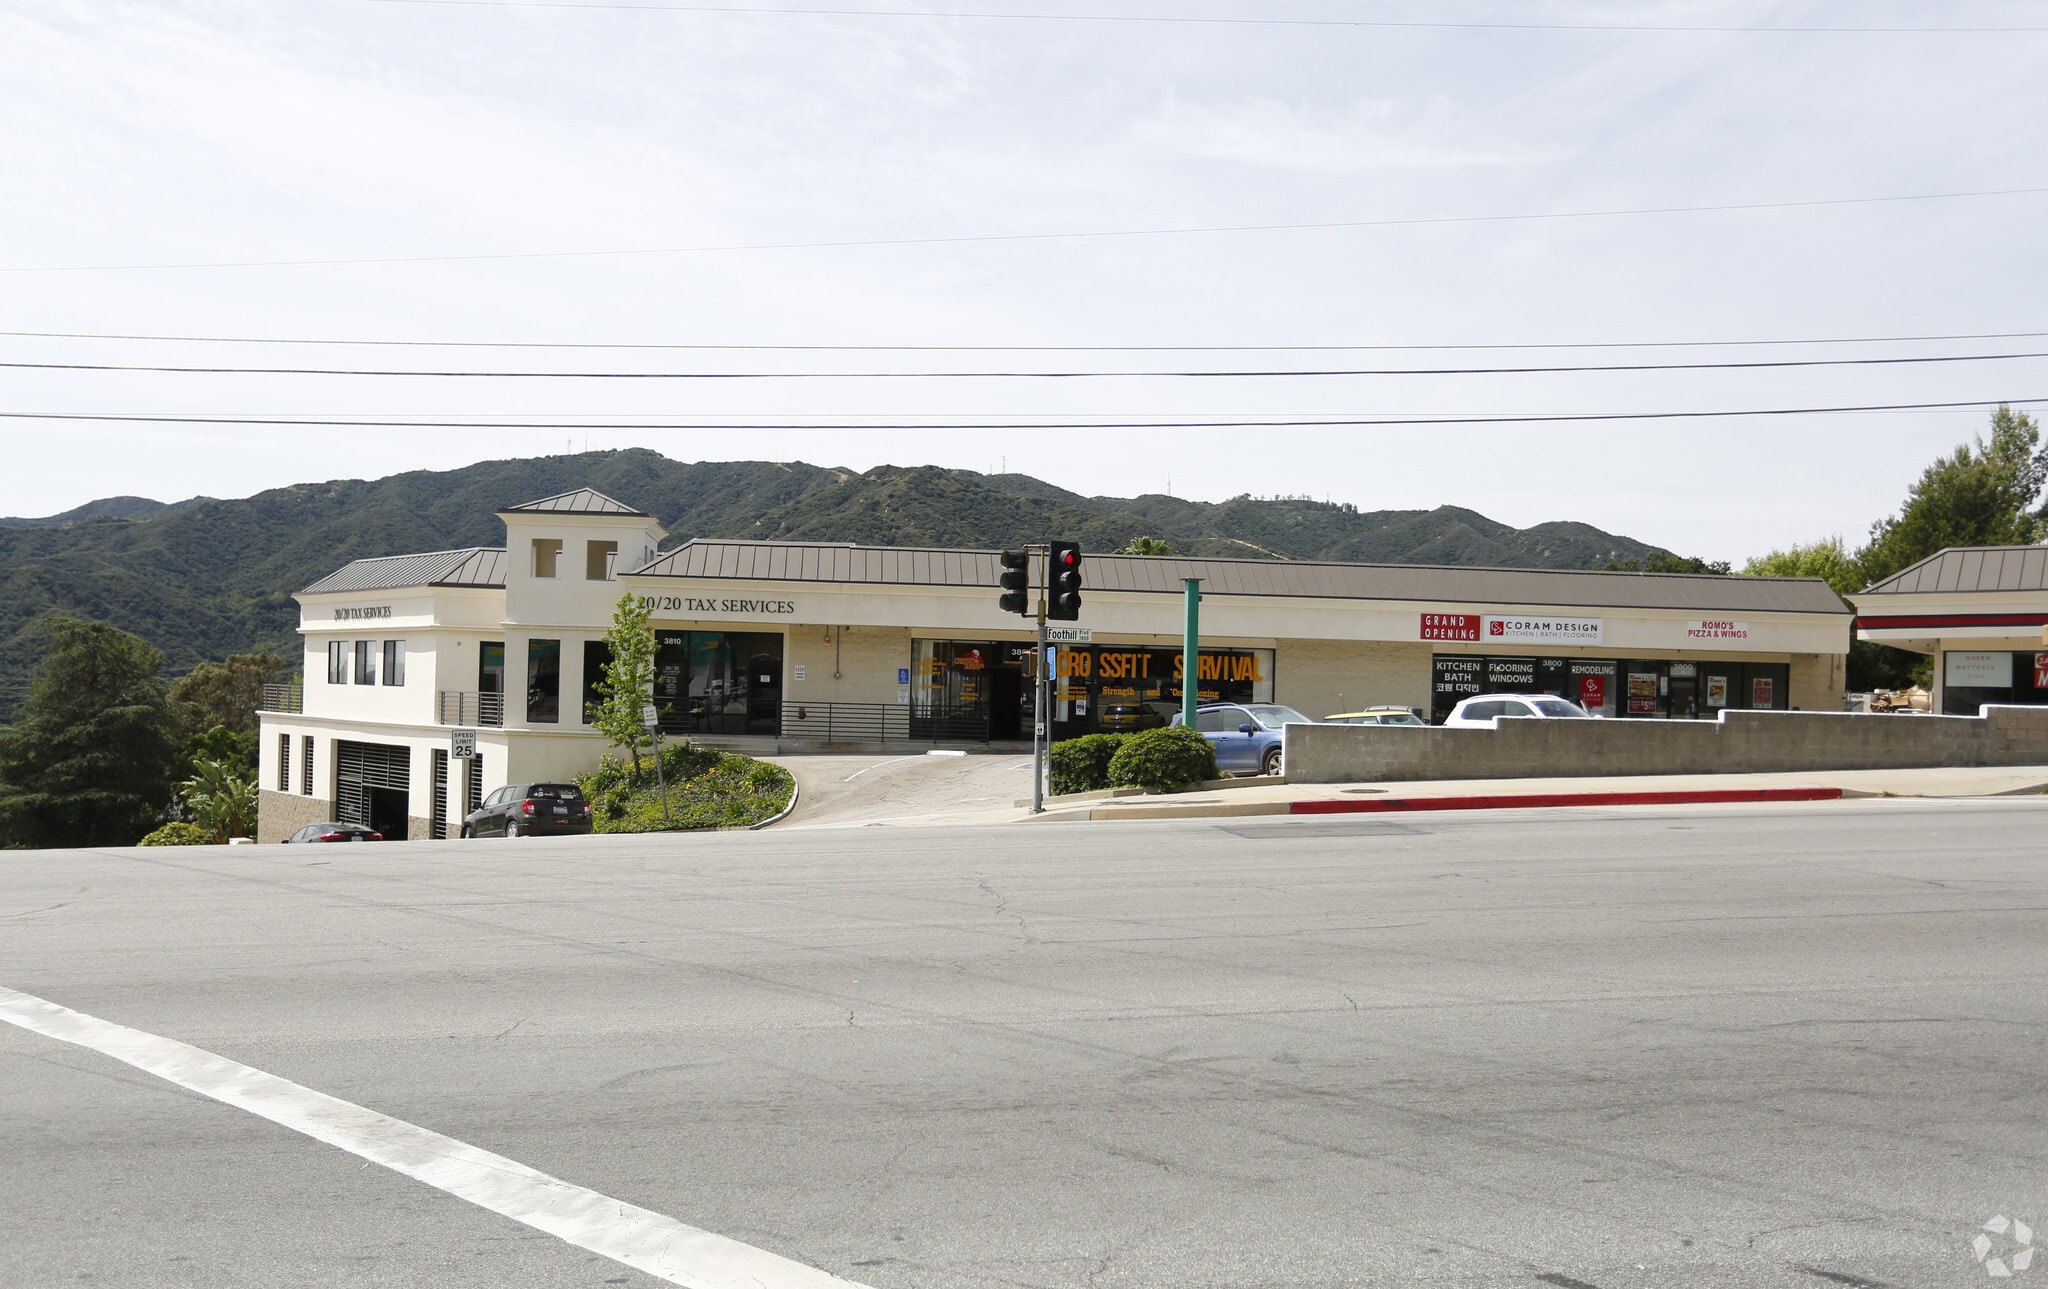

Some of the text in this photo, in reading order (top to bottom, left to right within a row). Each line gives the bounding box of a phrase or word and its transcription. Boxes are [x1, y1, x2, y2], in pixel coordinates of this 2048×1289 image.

[639, 596, 795, 614] 20/20 TAX SERVICES
[334, 606, 392, 621] 20/20 TAX SERVICES
[1425, 615, 1465, 627] GRAND
[1701, 621, 1734, 630] ROMO'S
[1505, 621, 1598, 632] CORAM DESIGN
[1048, 628, 1078, 640] Foothill
[1424, 628, 1475, 640] OPENING
[1687, 629, 1747, 639] PIZZA & WINGS
[664, 637, 682, 645] 3810
[1172, 654, 1264, 682] SRVIVAL
[1436, 661, 1480, 671] KITCHEN
[1488, 663, 1533, 673] FLOORING
[1542, 659, 1563, 667] 3800
[1673, 663, 1693, 671] 3800
[1571, 665, 1614, 675] REMODELING
[1444, 672, 1472, 682] BATH
[1489, 674, 1533, 683] WINDOWS
[1102, 685, 1135, 698] Strength
[1146, 687, 1161, 697] and
[1455, 683, 1479, 693] 디자인
[455, 745, 472, 757] 25
